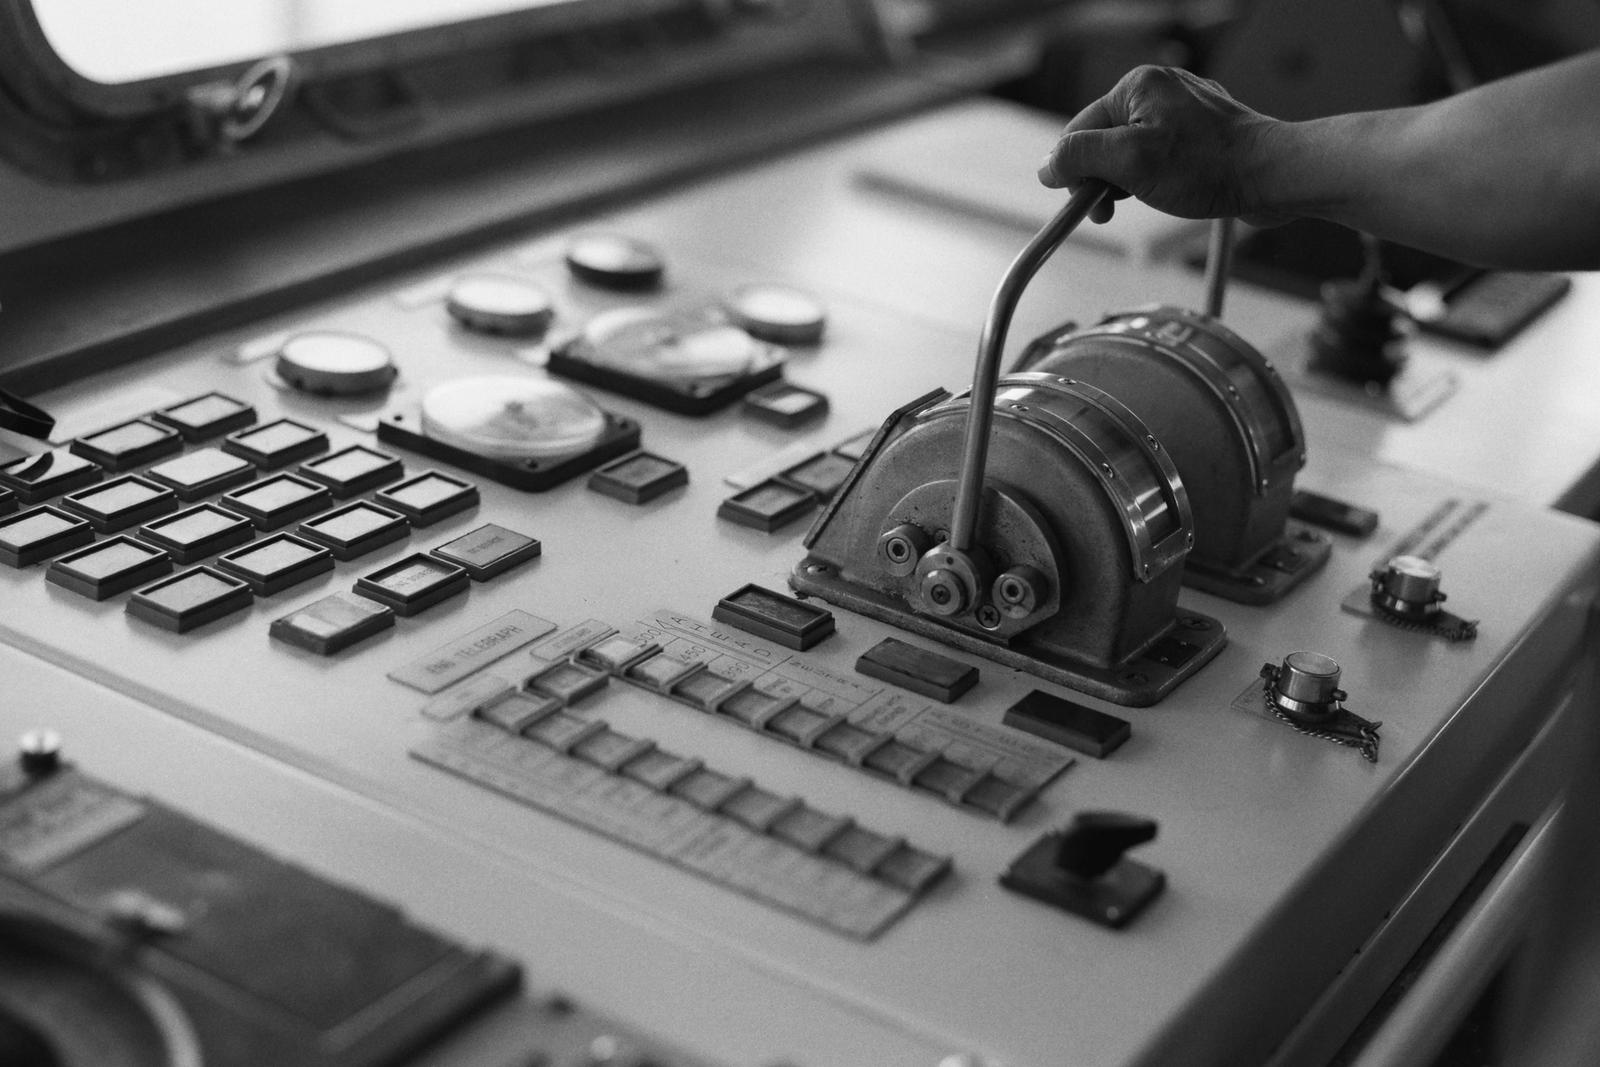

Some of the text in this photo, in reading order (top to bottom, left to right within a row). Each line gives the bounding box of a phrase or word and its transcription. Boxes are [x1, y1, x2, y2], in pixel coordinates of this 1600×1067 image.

[456, 625, 523, 658] TELEGRAPH
[671, 616, 772, 657] AHEAD
[680, 645, 707, 664] 450
